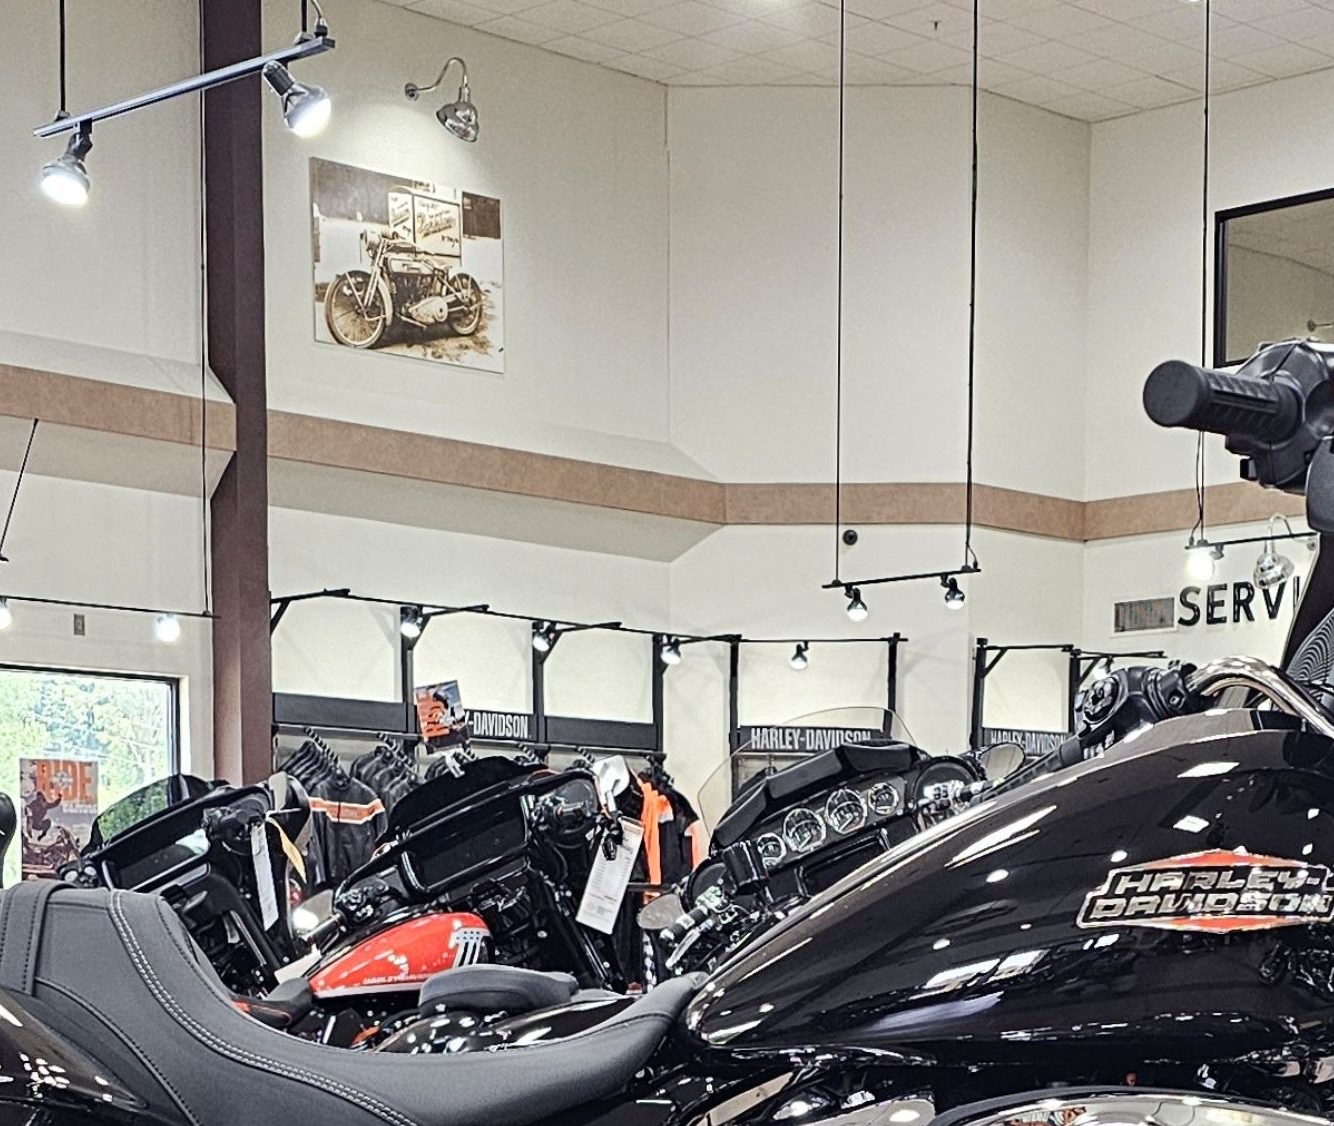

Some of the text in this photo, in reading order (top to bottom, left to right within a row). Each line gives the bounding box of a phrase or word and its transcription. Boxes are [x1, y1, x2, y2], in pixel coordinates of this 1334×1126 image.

[37, 760, 93, 804] RIDE
[1115, 867, 1320, 894] HARLEY-
[1088, 891, 1333, 919] DAVIDSON
